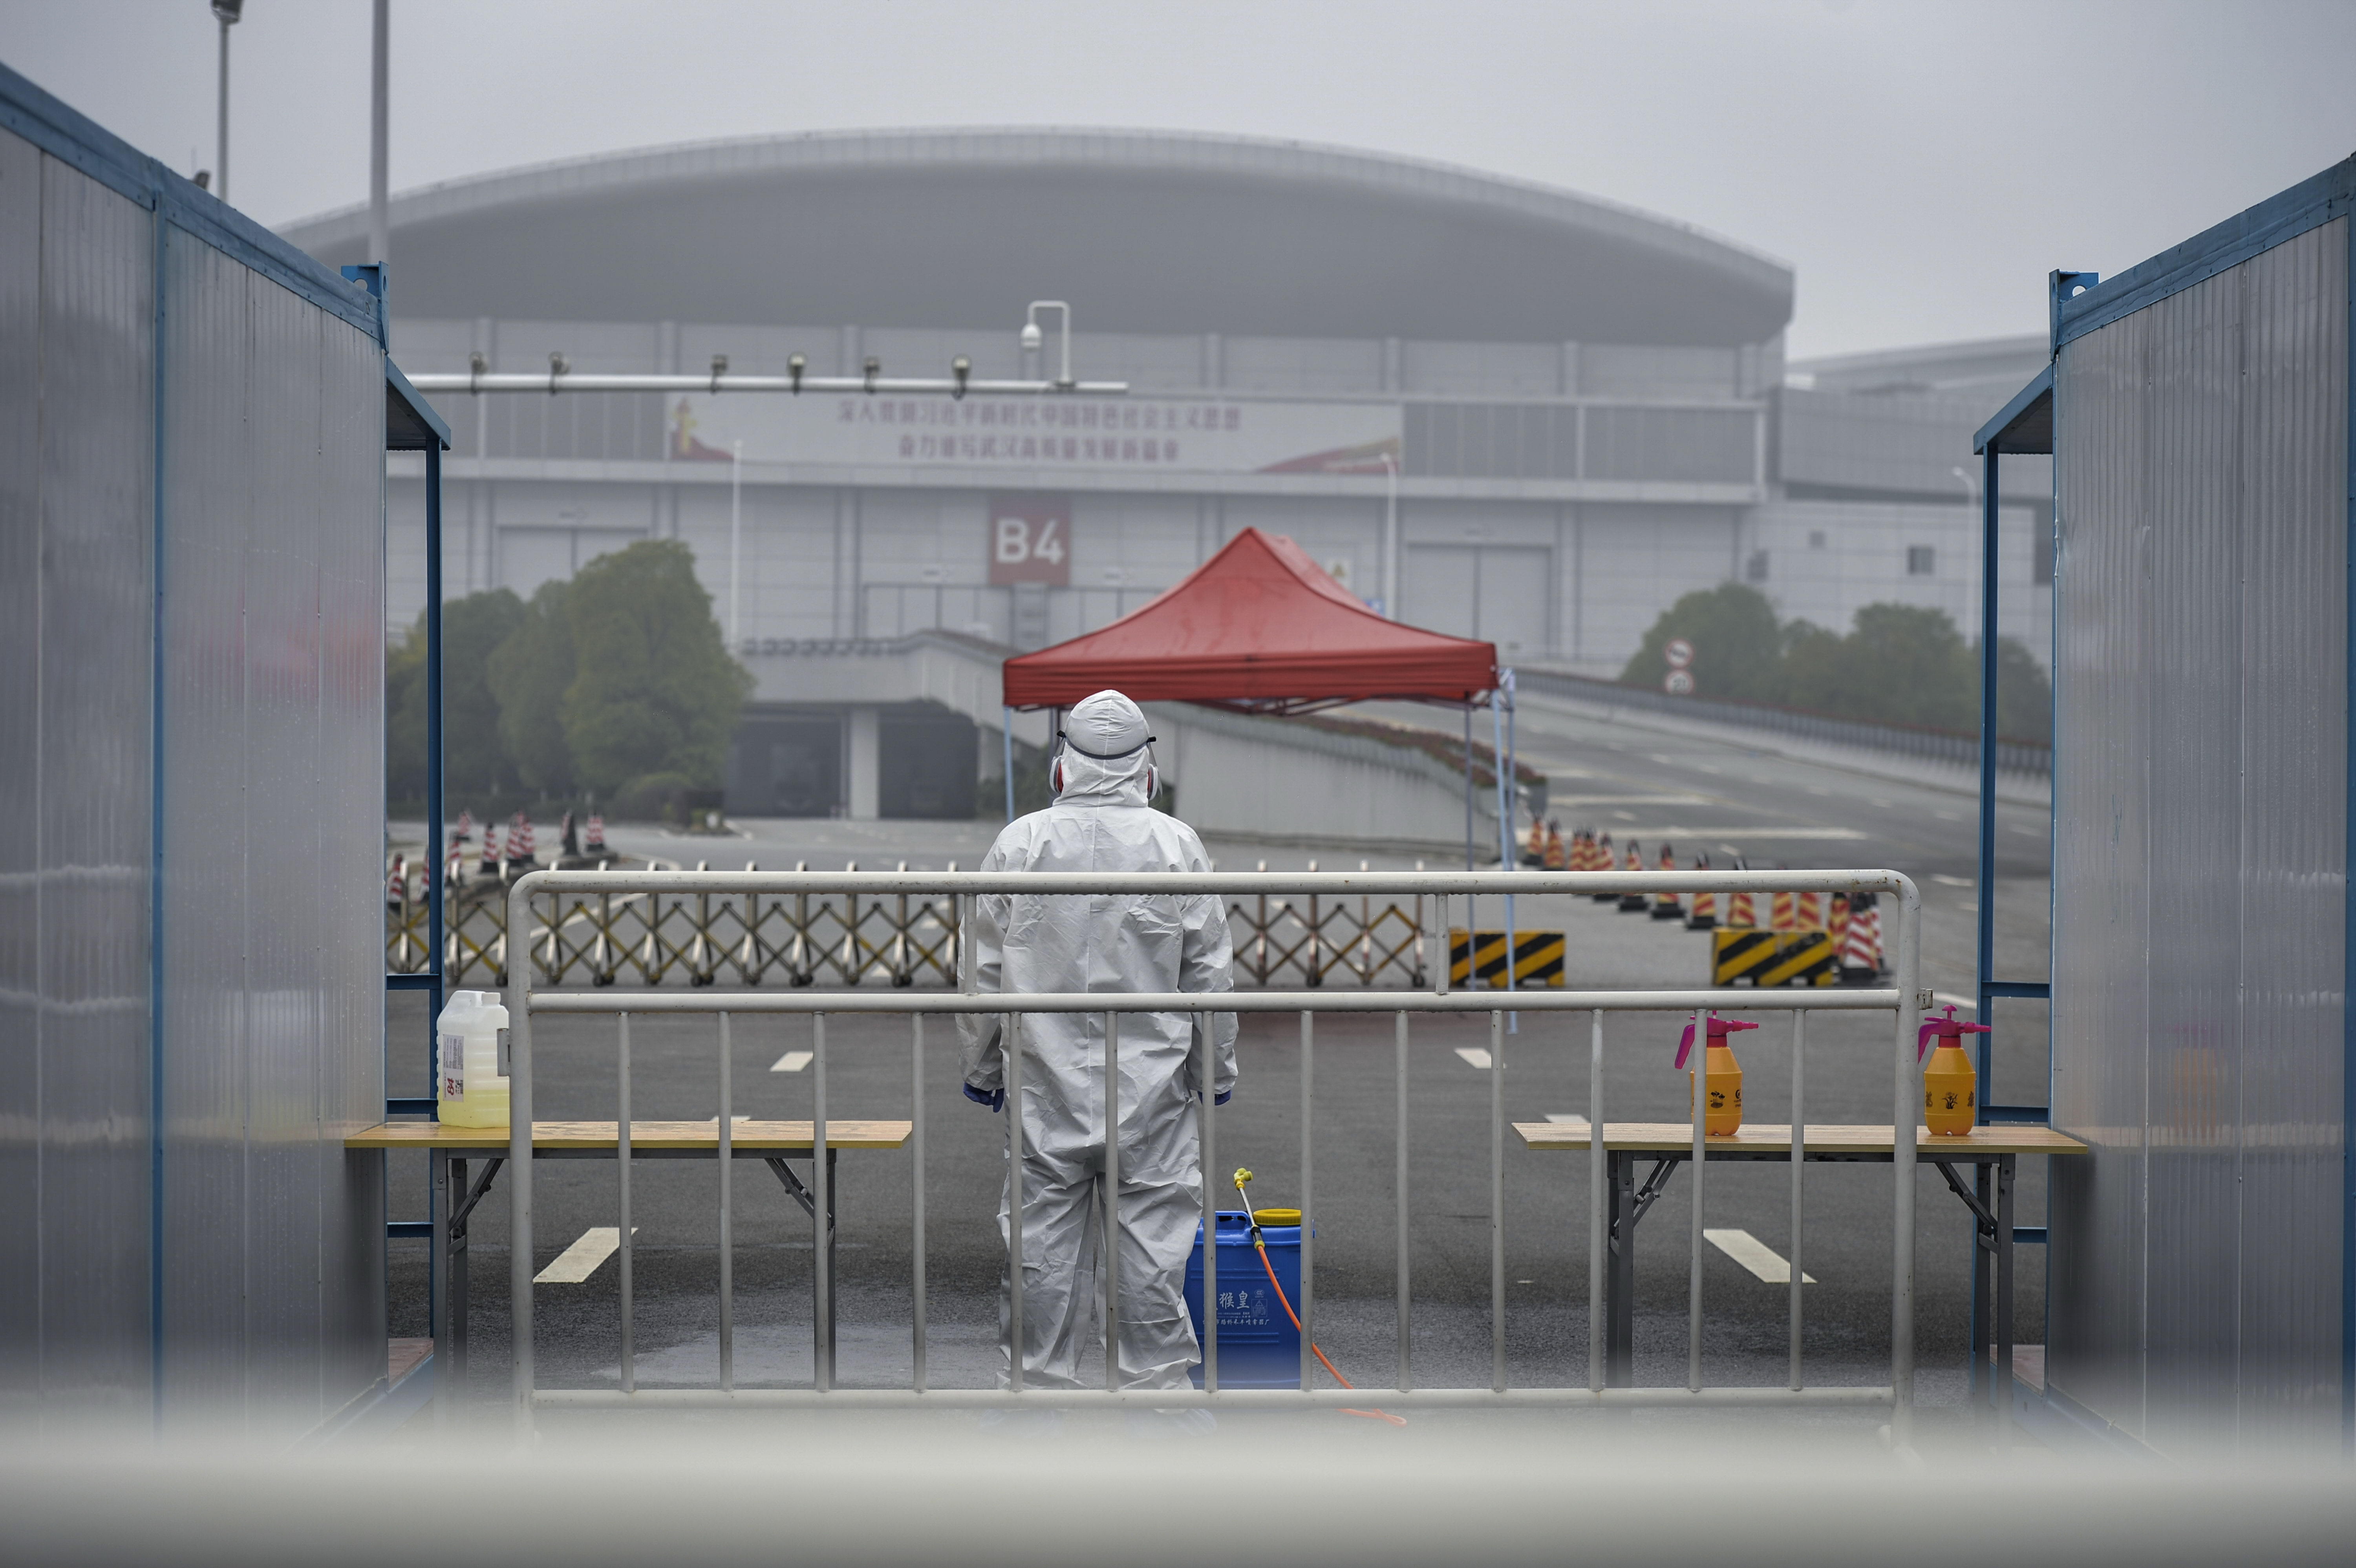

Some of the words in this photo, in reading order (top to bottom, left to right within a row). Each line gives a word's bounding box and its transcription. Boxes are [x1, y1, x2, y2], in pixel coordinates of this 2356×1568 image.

[996, 517, 1065, 565] B4
[447, 1078, 454, 1095] 84
[1204, 1290, 1249, 1310] 猴皇
